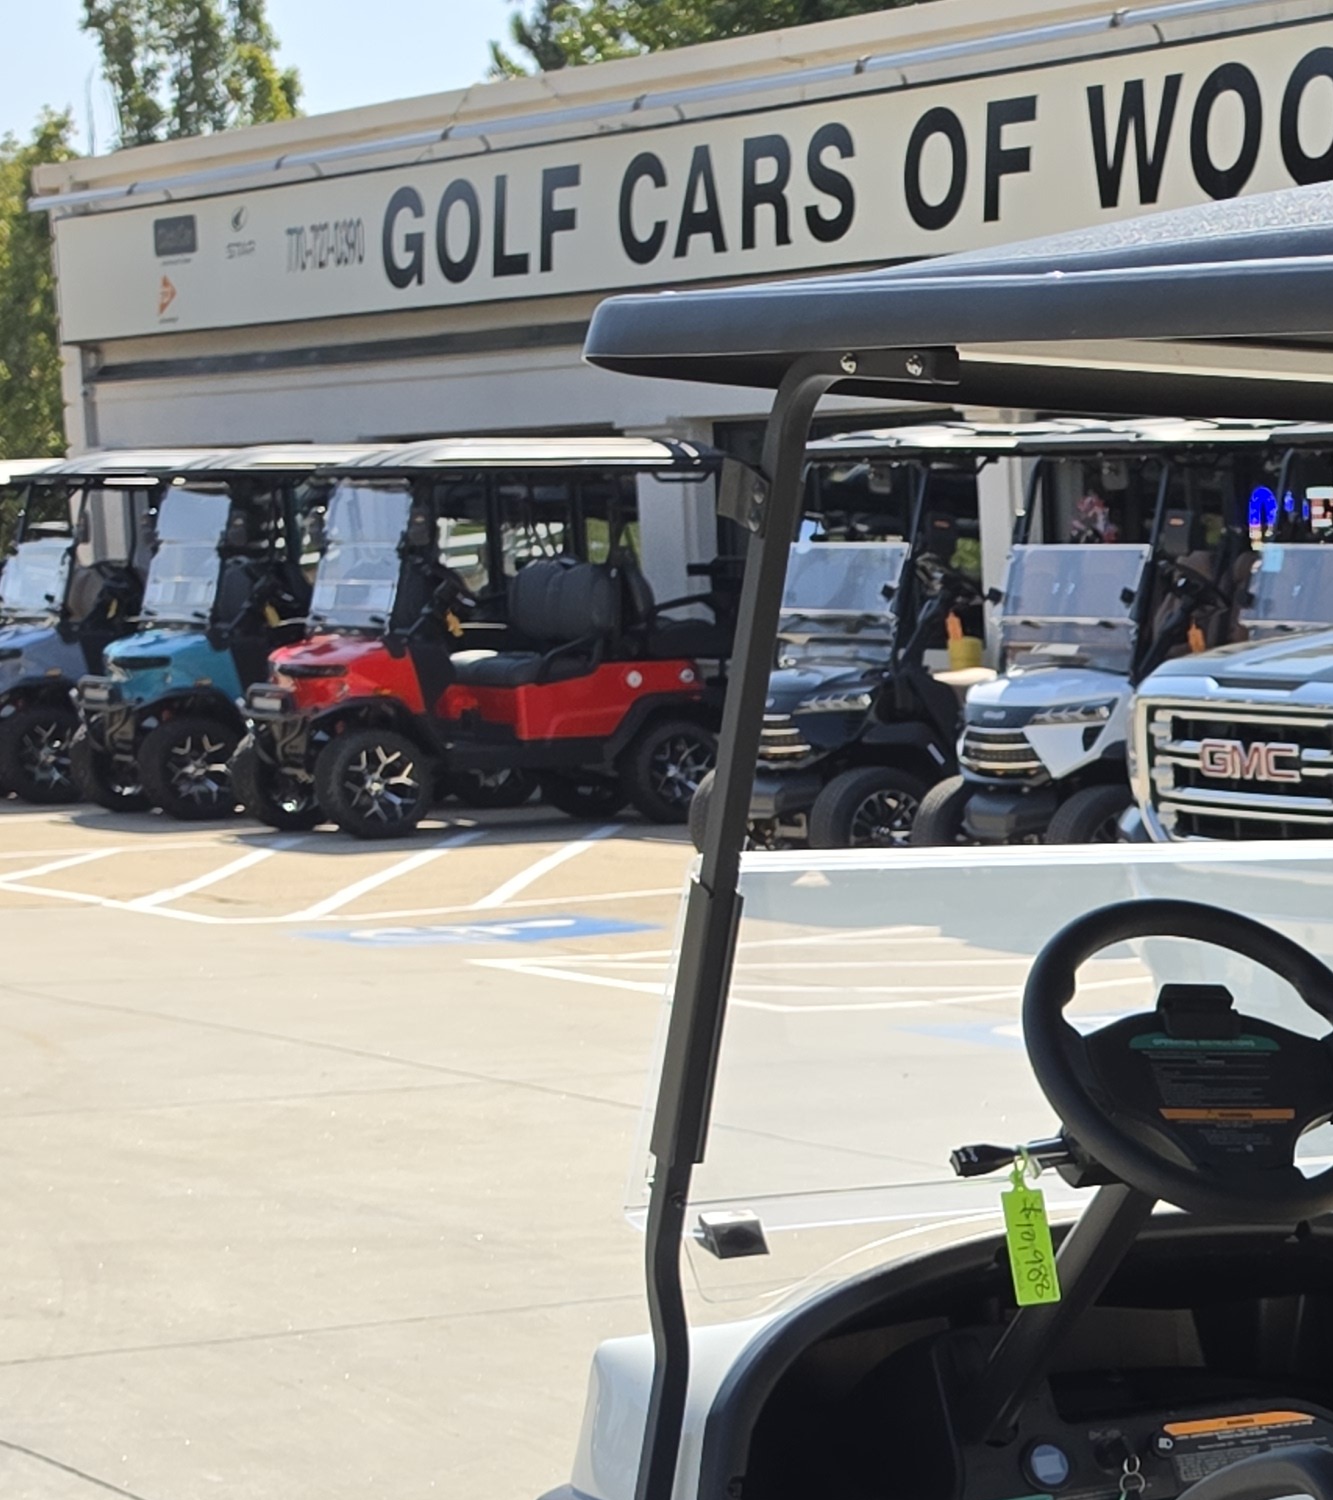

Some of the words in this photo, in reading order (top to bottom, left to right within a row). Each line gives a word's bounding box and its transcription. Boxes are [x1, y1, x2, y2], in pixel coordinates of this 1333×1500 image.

[382, 164, 582, 289] GOLF
[619, 122, 856, 266] CARS
[904, 96, 1038, 231] OF
[1199, 738, 1302, 783] GMC
